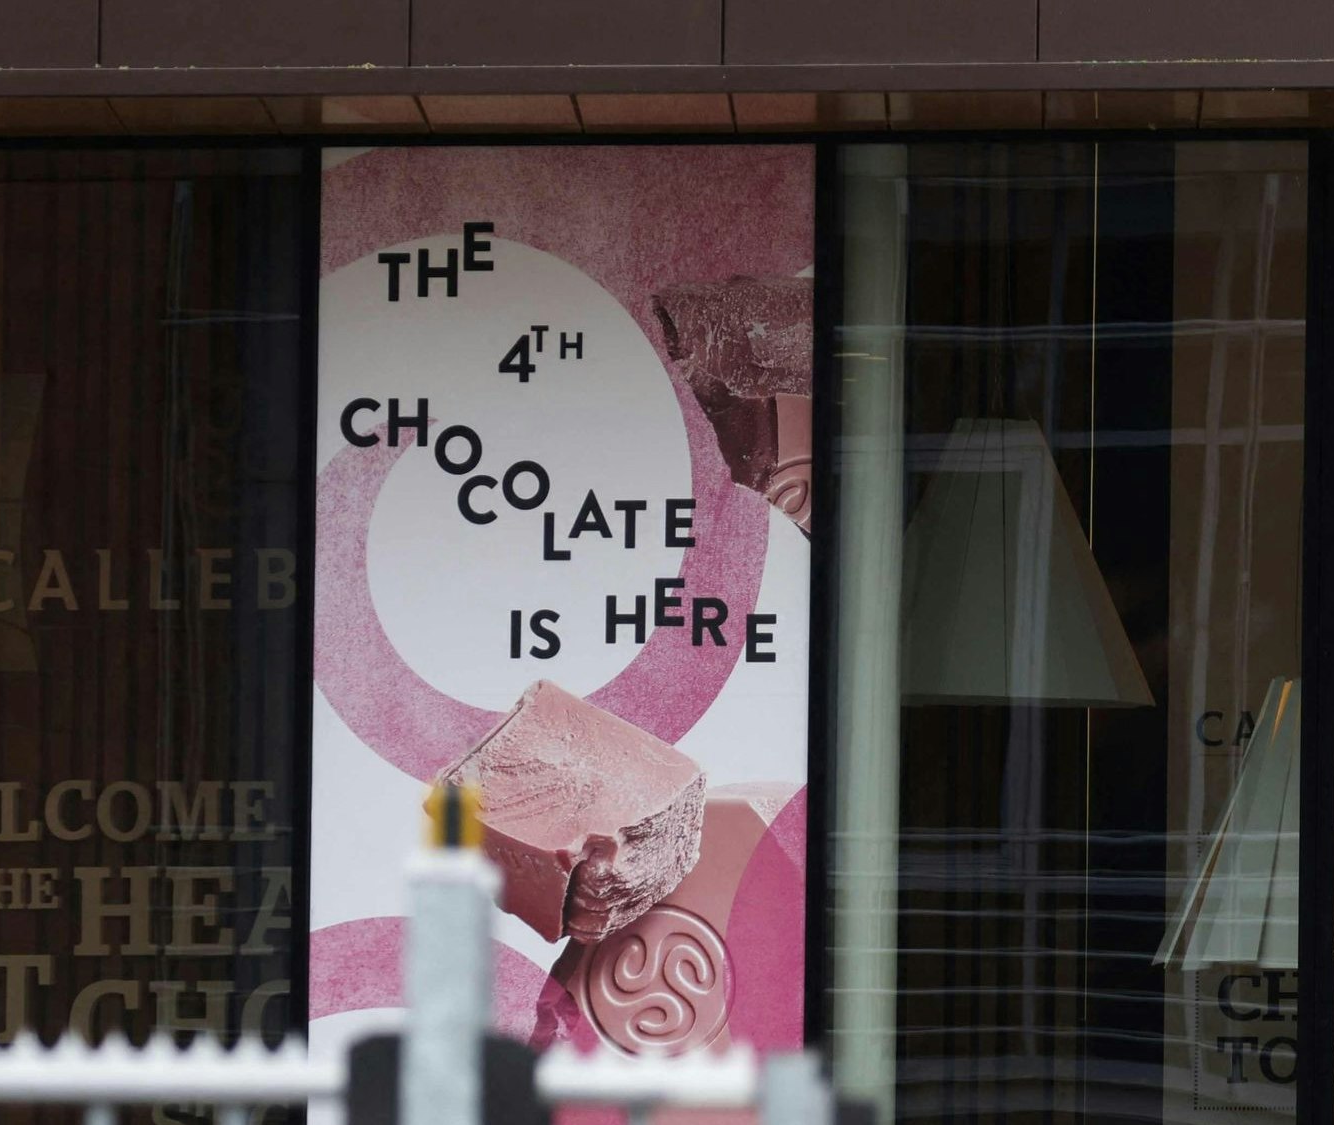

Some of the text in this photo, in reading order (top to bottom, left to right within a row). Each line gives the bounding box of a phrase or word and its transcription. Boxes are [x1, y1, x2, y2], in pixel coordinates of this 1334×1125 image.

[378, 221, 494, 302] THE
[498, 324, 584, 382] 4TH
[339, 397, 697, 562] CHOCOLATE
[509, 577, 778, 662] IS HERE
